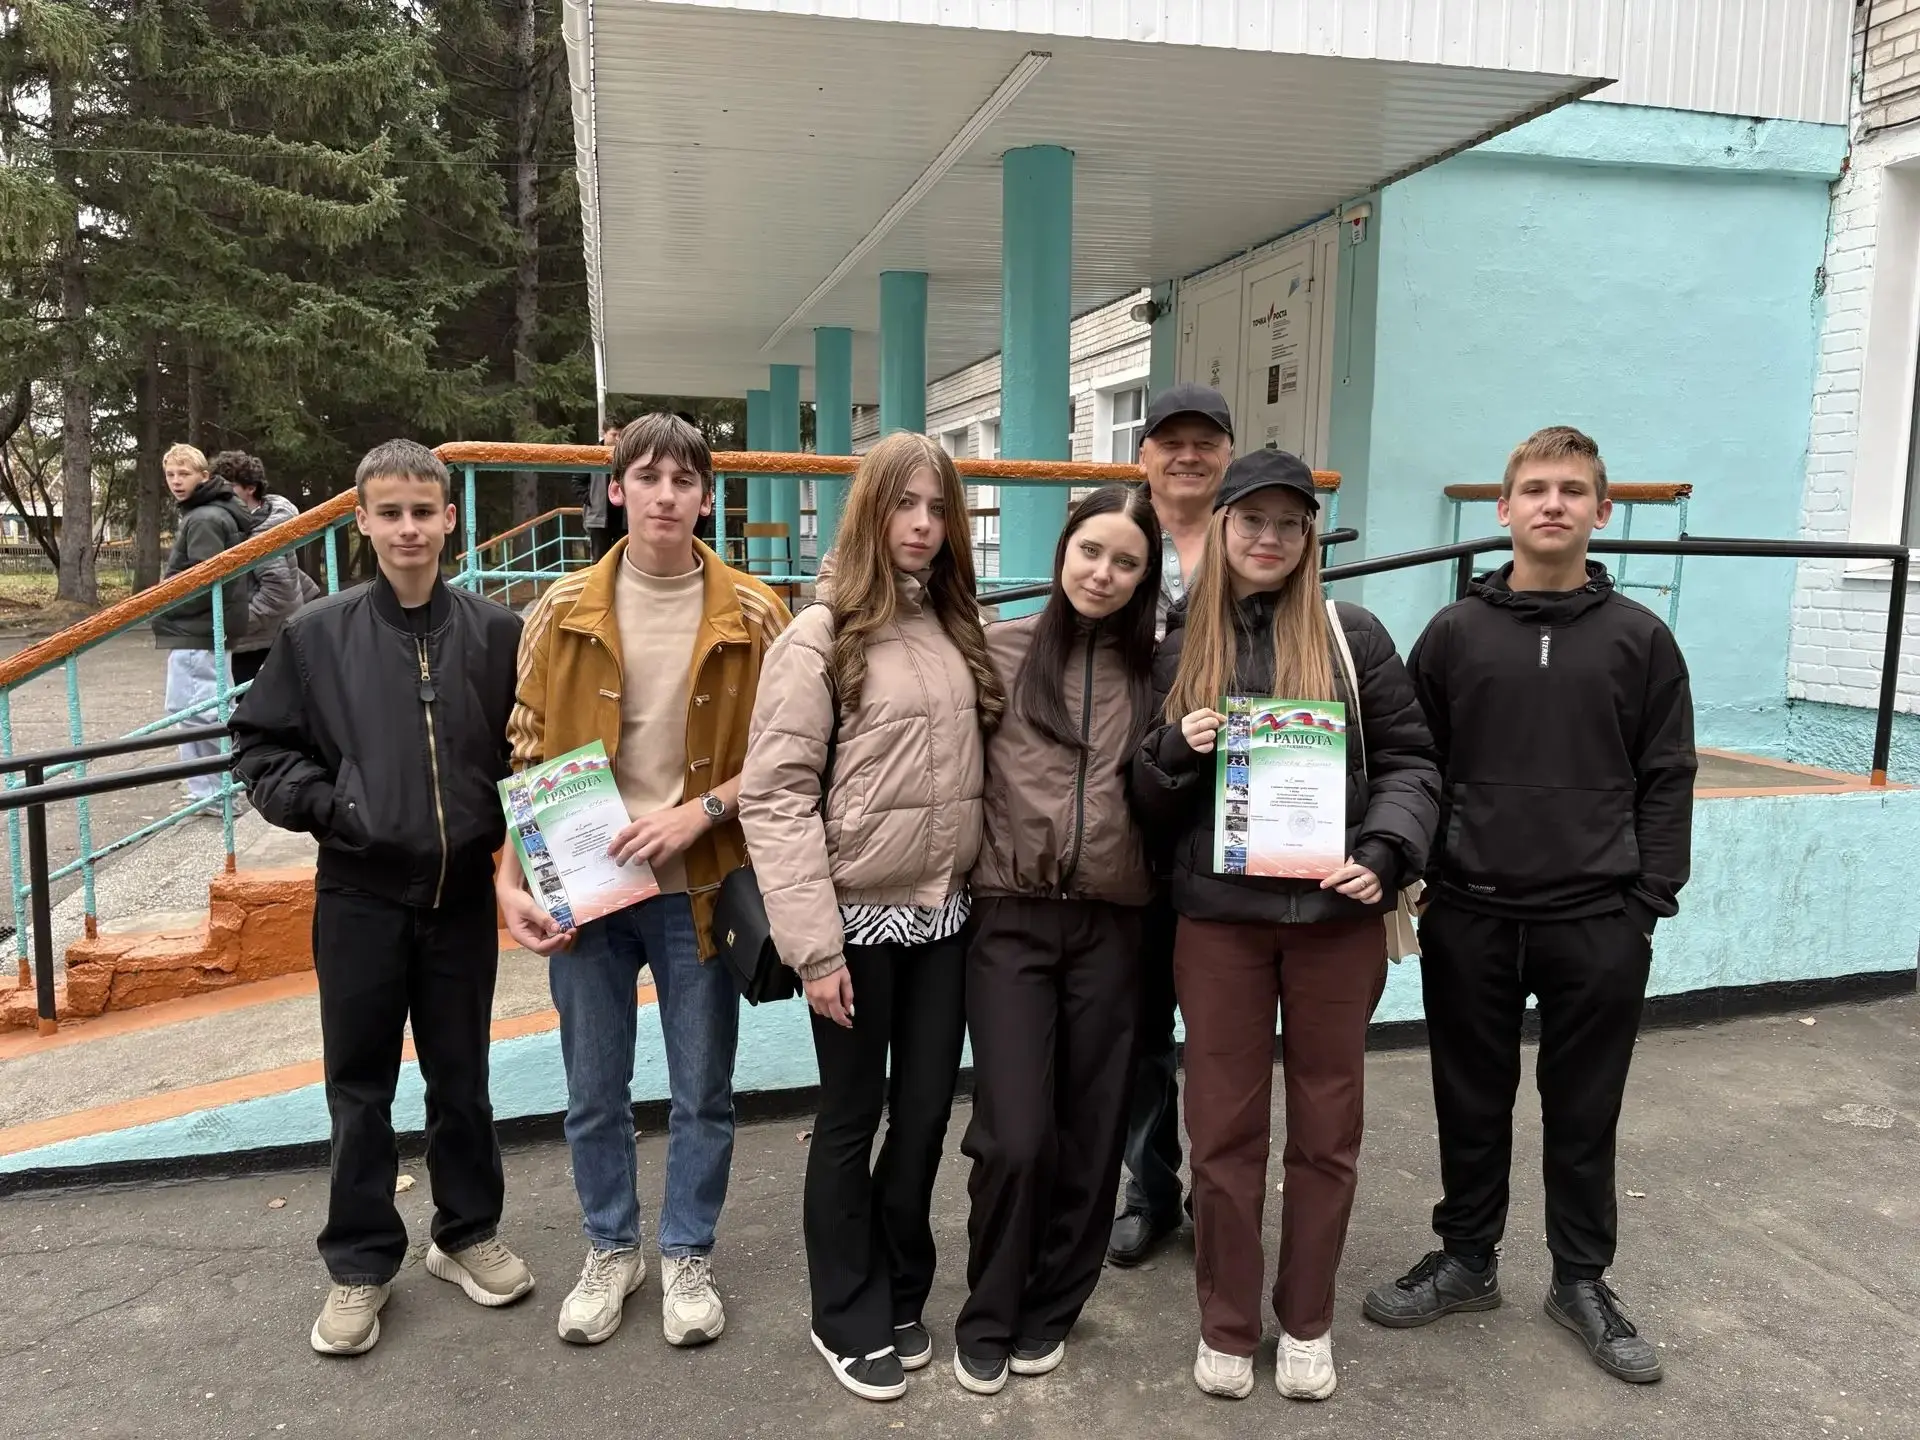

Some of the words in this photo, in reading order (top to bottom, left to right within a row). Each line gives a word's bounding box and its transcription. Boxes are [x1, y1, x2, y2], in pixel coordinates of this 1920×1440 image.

[1252, 316, 1267, 327] ТОЧКА
[1272, 309, 1288, 320] РОСТА
[1541, 641, 1549, 666] TERREX
[1265, 732, 1333, 746] ГРАМОТА
[543, 775, 602, 804] ГРАМОТА
